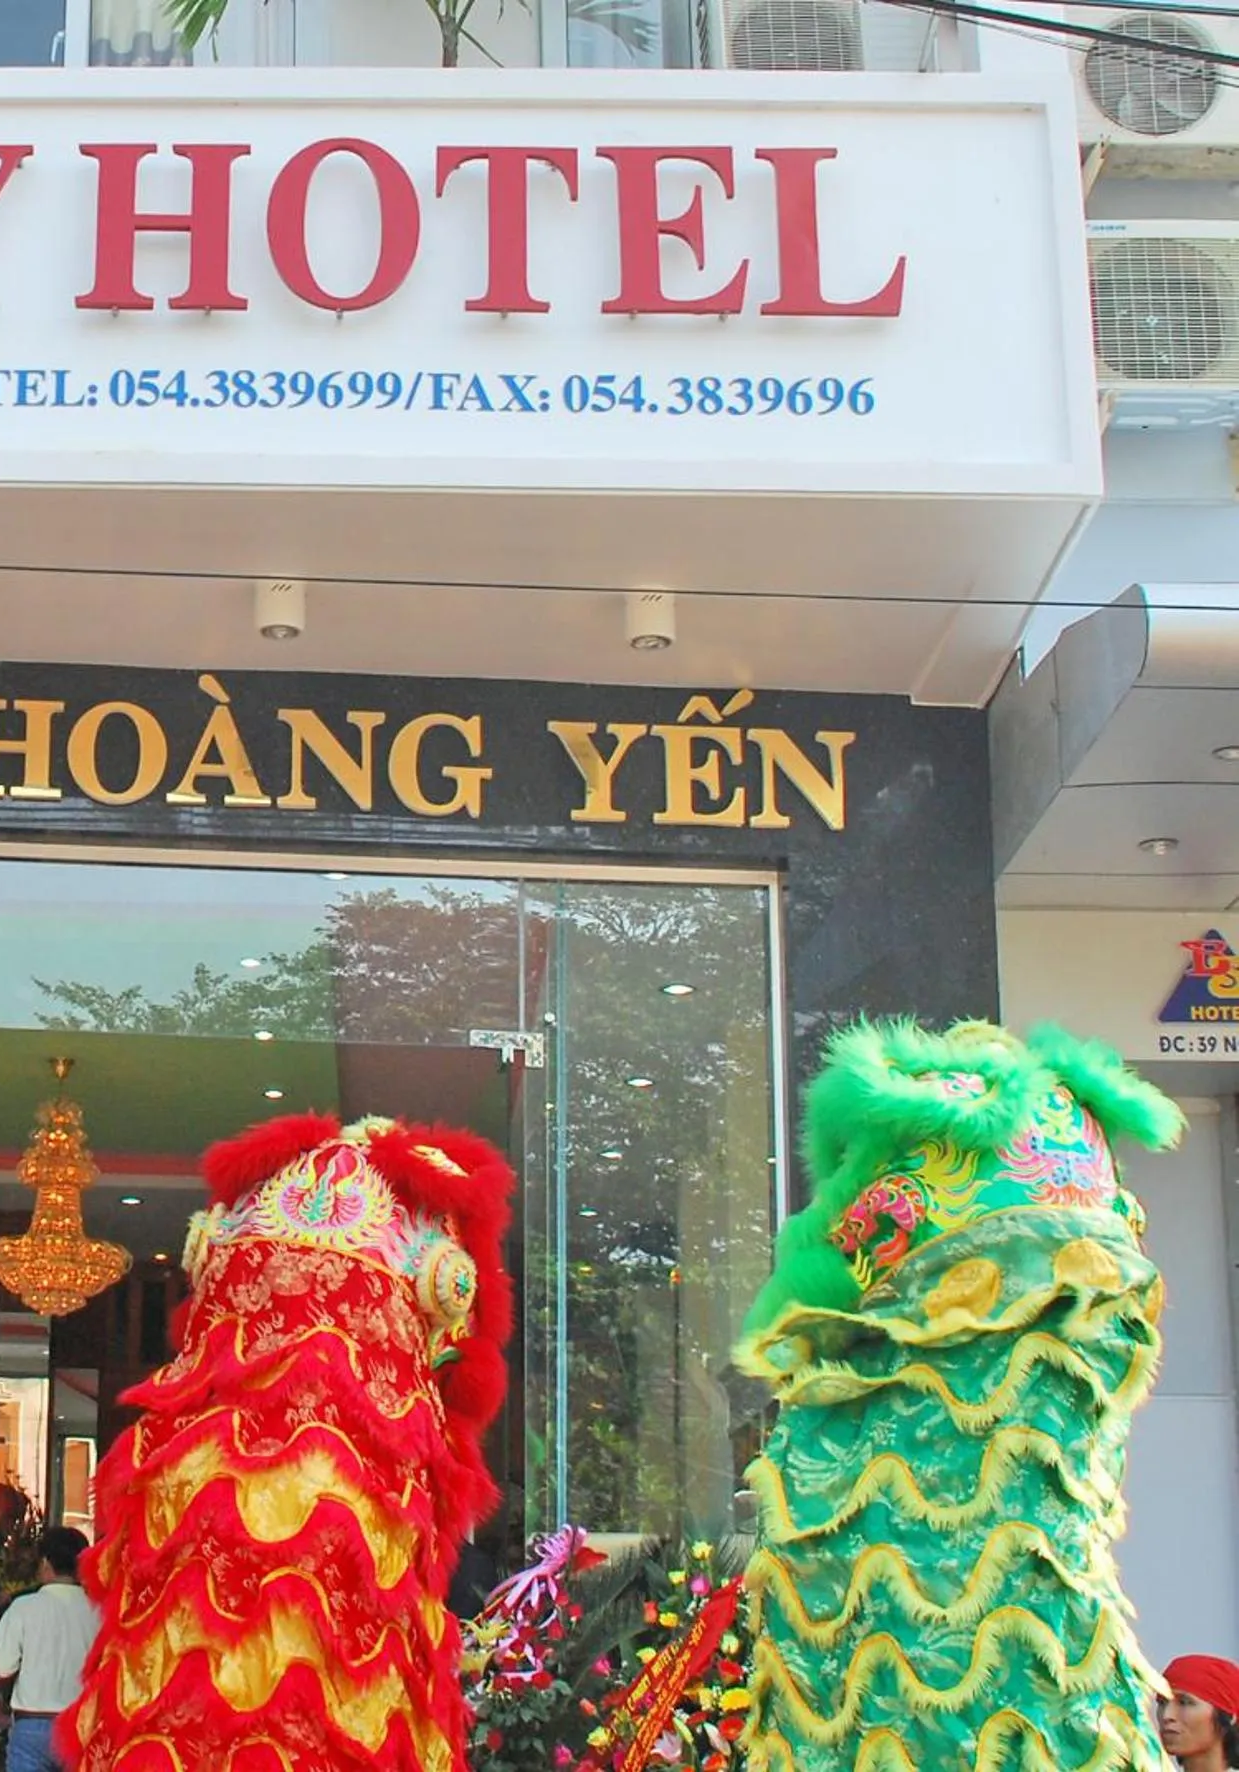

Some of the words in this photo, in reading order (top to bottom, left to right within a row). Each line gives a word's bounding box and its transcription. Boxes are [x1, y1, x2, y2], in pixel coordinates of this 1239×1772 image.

[74, 136, 907, 317] HOTEL
[562, 374, 876, 416] 054.3839696
[547, 687, 856, 831] YẾN
